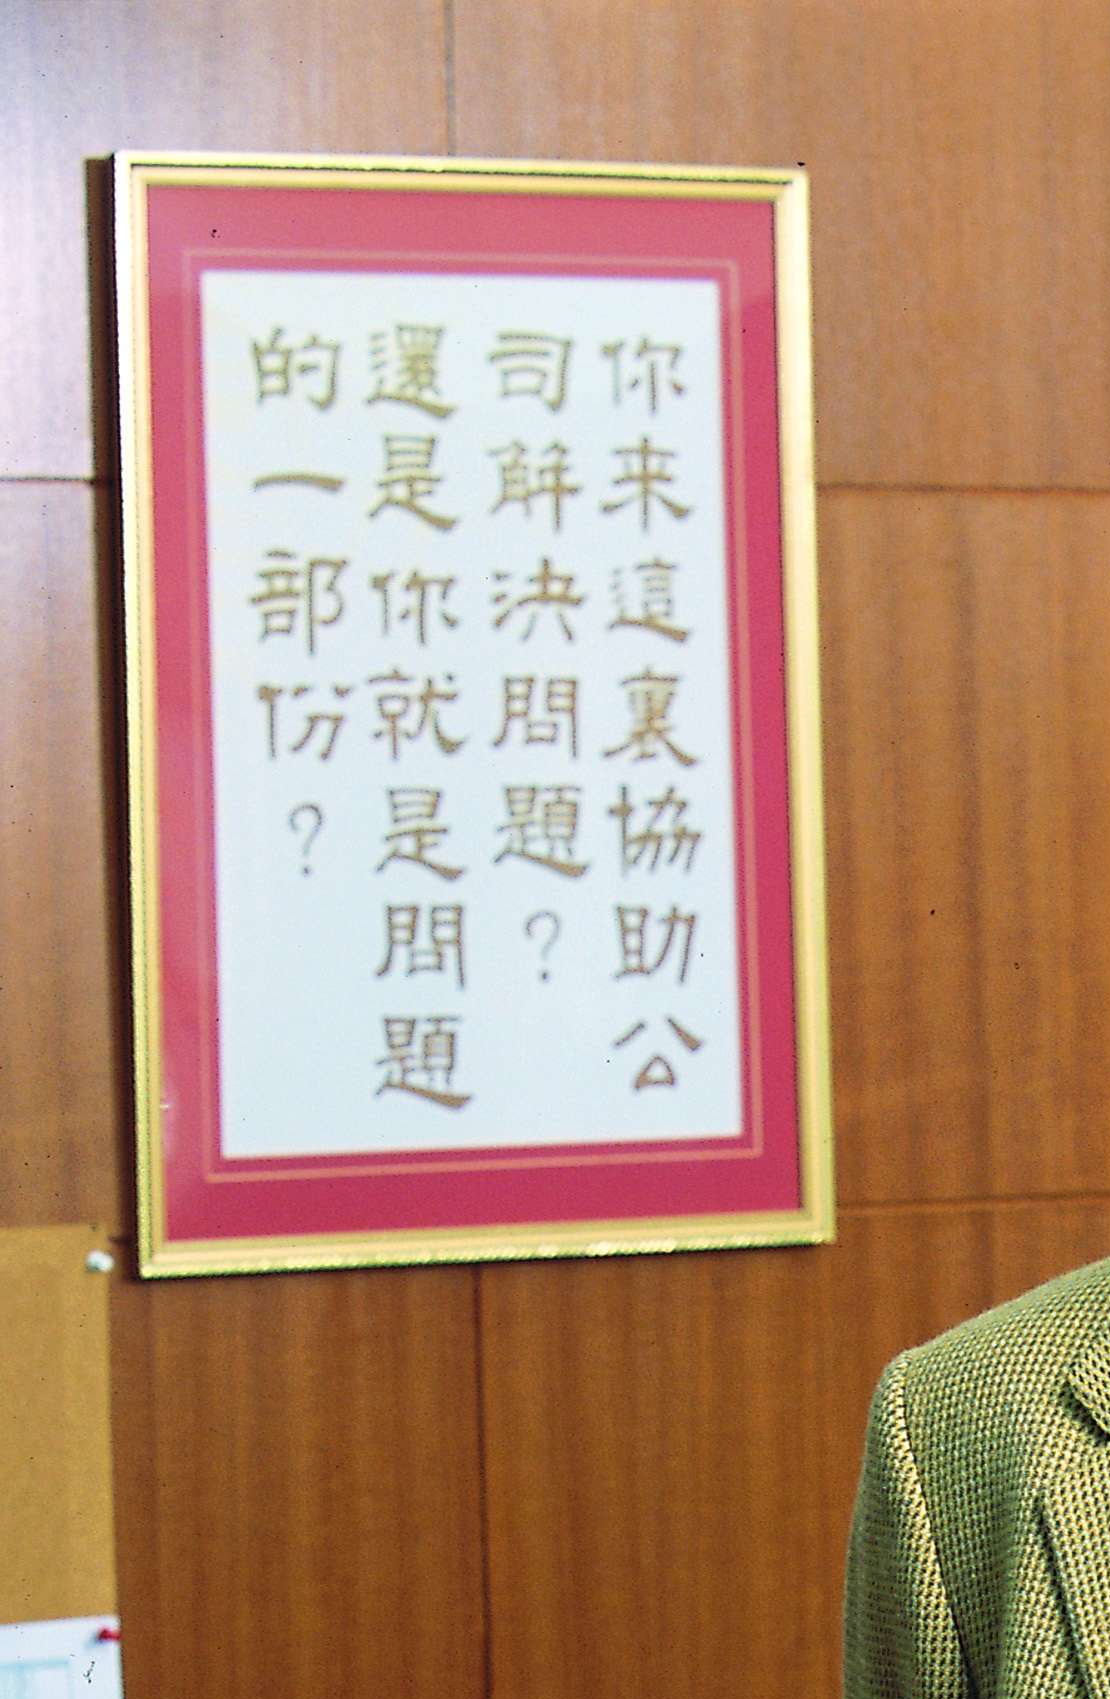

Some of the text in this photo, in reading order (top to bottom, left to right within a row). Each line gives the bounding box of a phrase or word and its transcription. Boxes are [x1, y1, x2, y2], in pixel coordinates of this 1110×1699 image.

[364, 324, 472, 1110] 還是你就是問題
